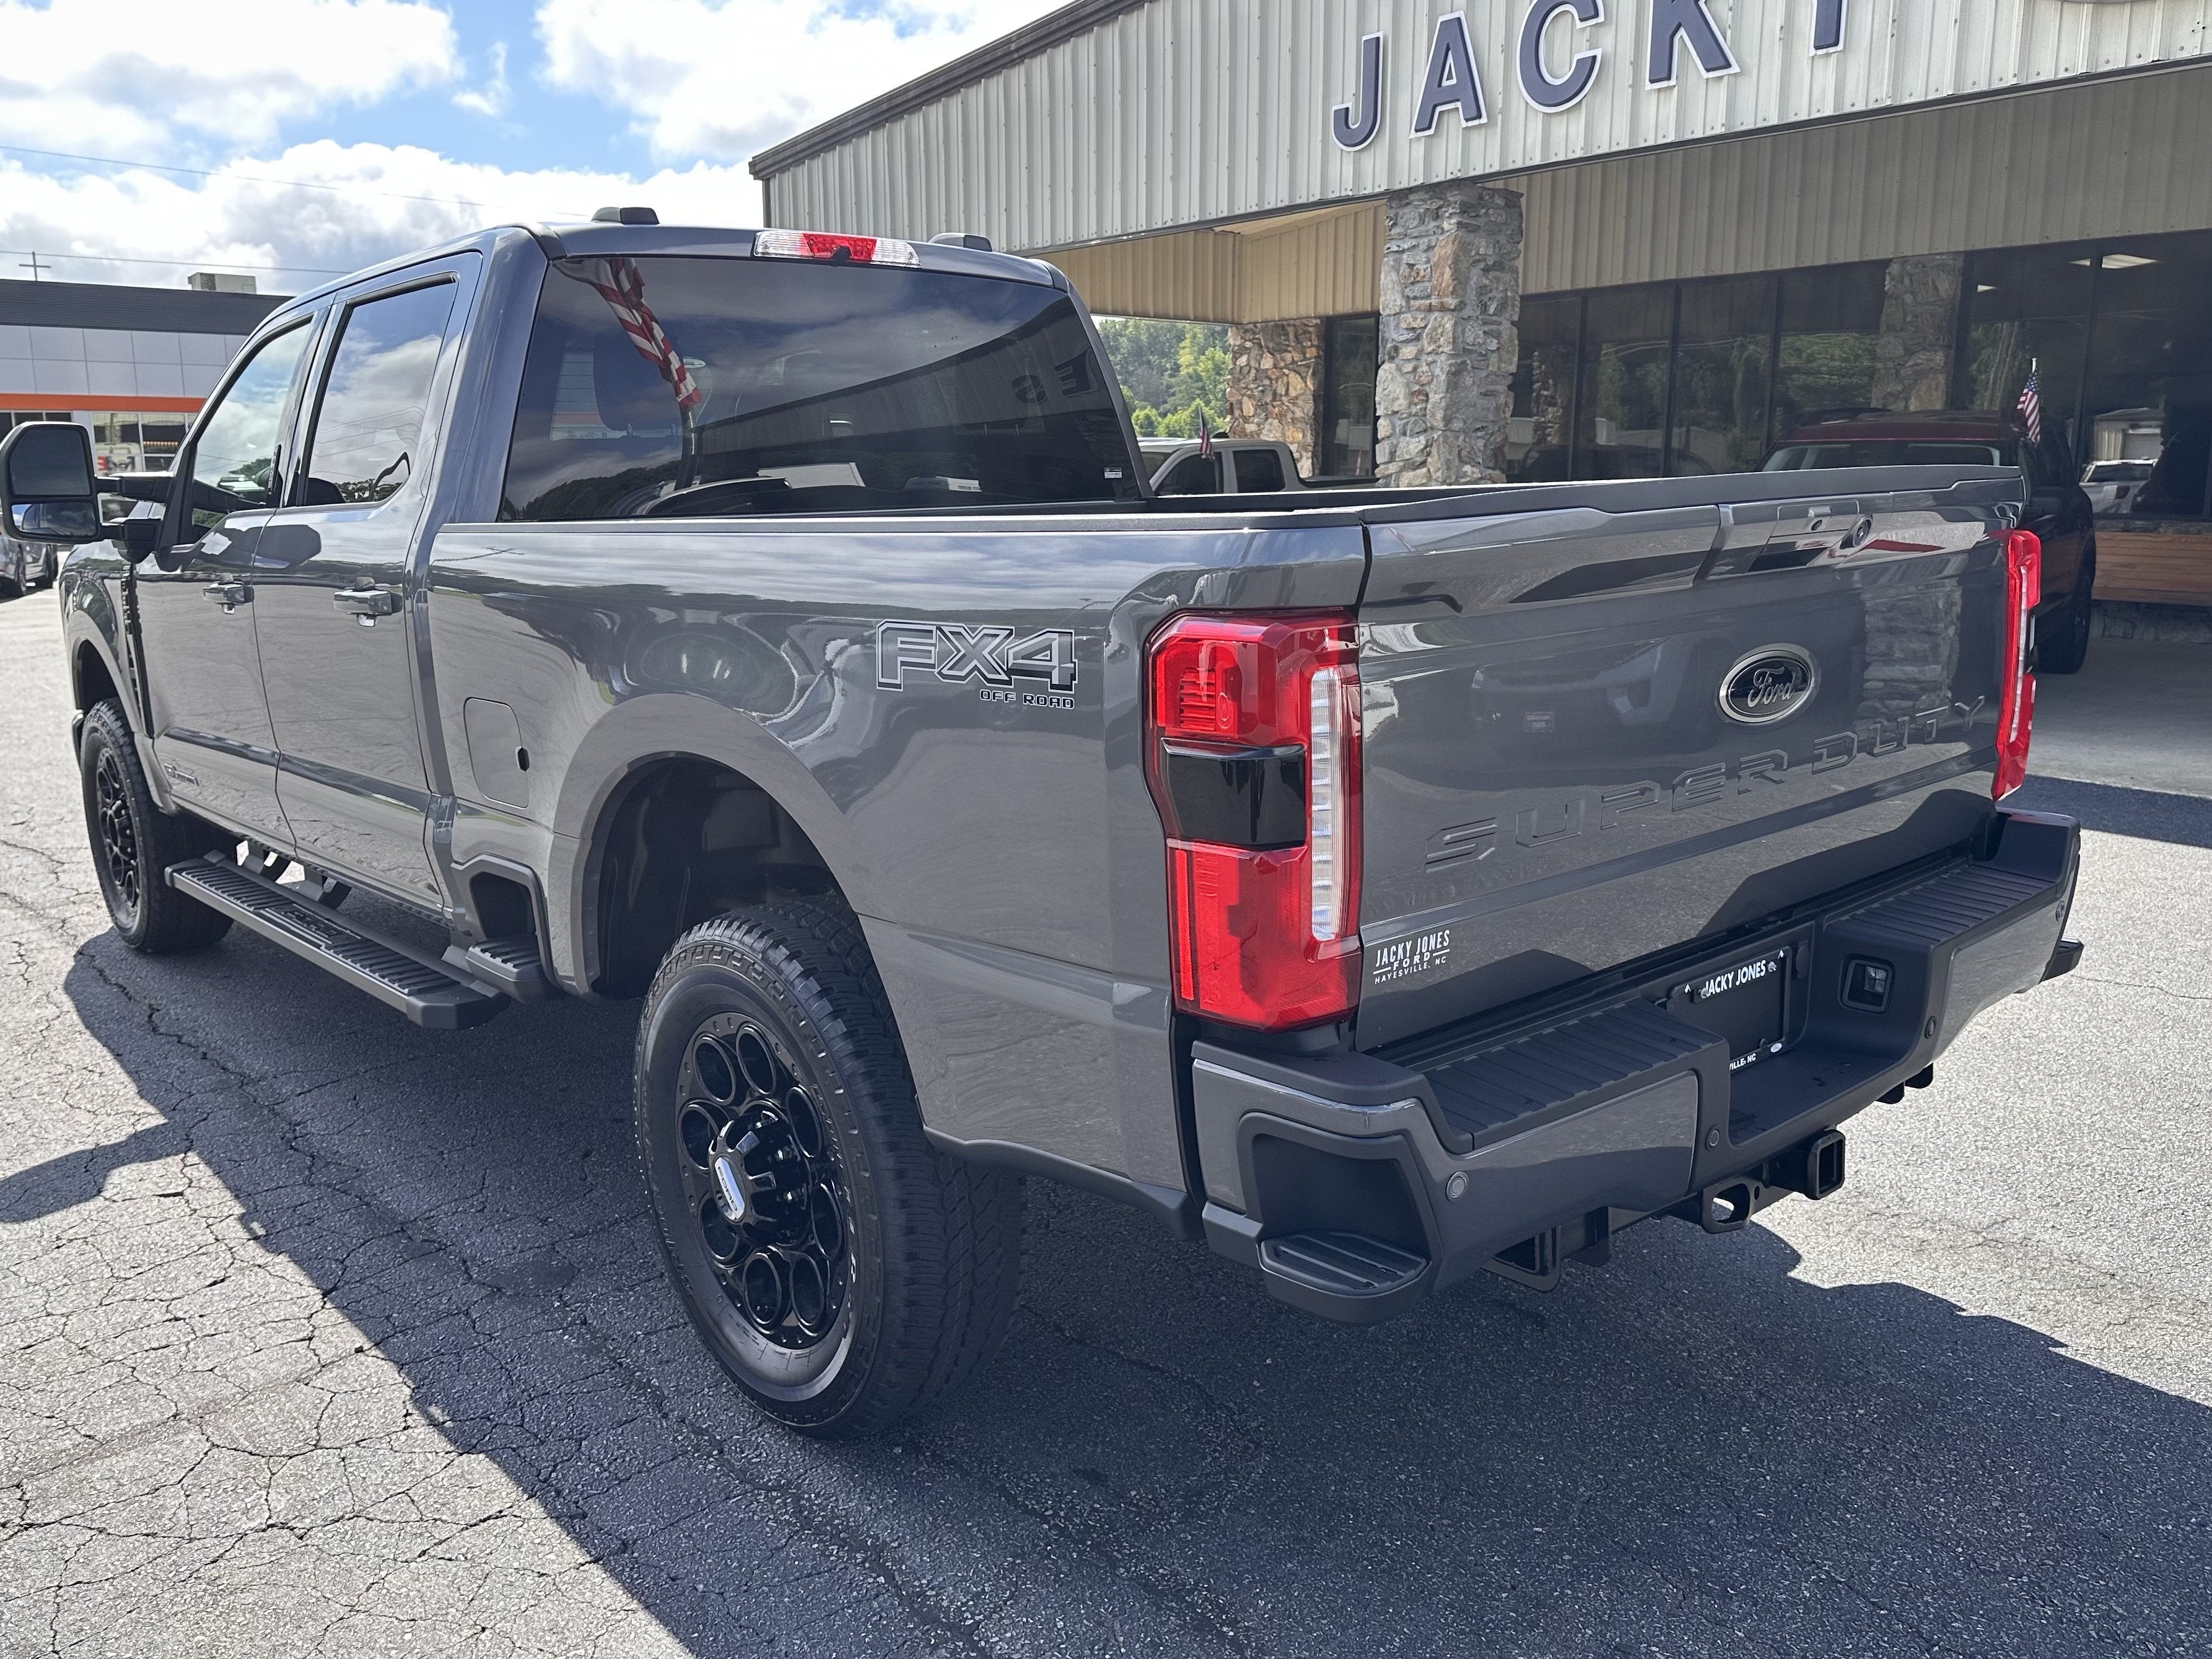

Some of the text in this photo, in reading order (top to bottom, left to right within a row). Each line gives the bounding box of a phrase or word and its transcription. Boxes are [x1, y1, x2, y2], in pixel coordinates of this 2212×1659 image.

[876, 619, 1078, 694] FX4
[980, 689, 1075, 710] OFF ROAD
[1747, 666, 1796, 707] Ford
[1424, 695, 1985, 874] SUPER DUTY
[1376, 929, 1450, 967] JACKY JONES
[1393, 952, 1430, 971] FORD
[1375, 956, 1447, 984] HAYESVILLE, NC
[1705, 960, 1766, 997] JACKY JONES
[1747, 1053, 1756, 1063] NC
